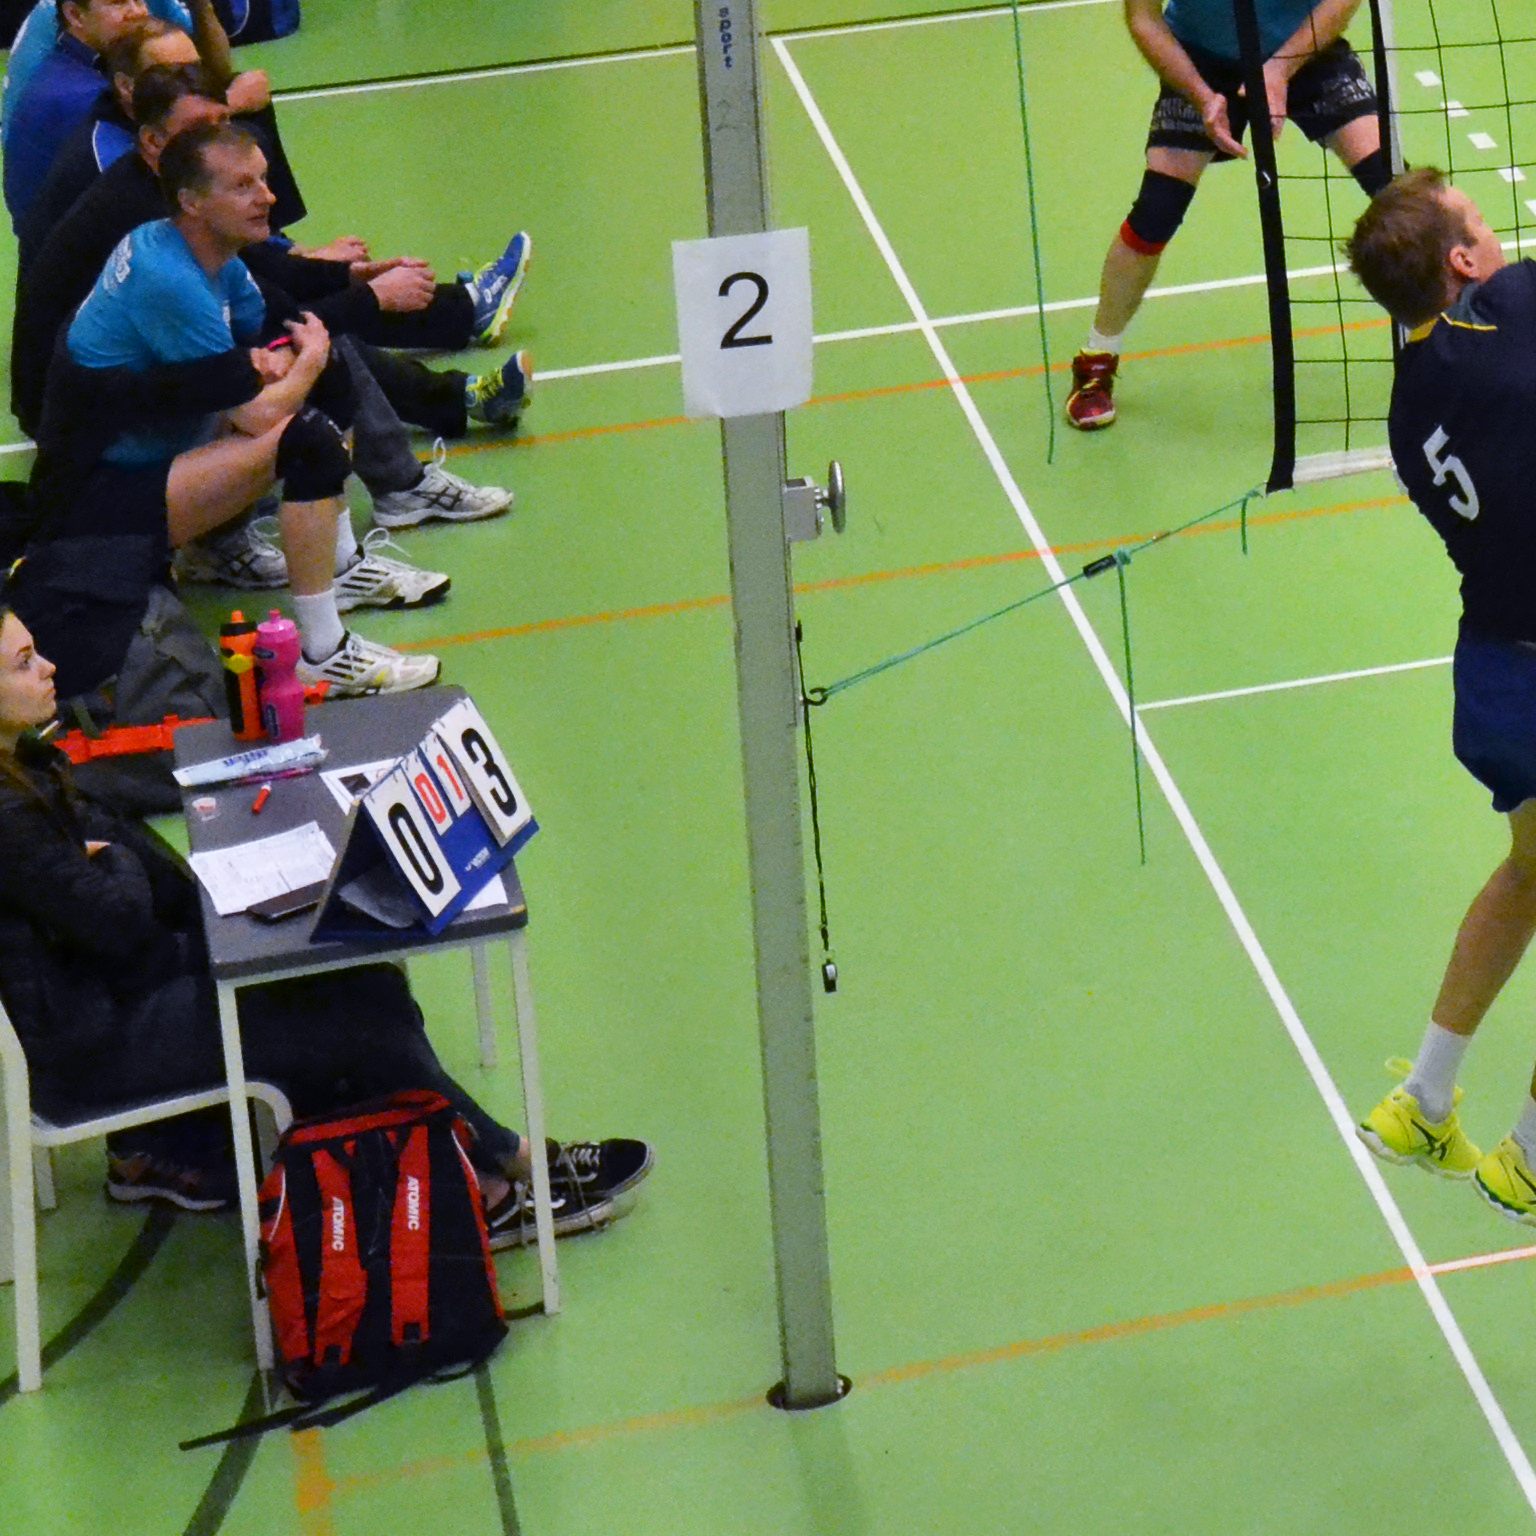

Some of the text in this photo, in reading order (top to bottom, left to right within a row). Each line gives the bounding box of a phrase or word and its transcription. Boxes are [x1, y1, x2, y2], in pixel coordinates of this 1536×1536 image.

[719, 7, 733, 71] sport
[718, 271, 773, 350] 2
[1422, 424, 1480, 521] 5
[414, 772, 447, 825] 0
[436, 753, 465, 802] 1
[460, 727, 518, 818] 3
[387, 801, 445, 896] 0
[331, 1195, 345, 1252] ATOMIC
[406, 1175, 420, 1231] ATOMIC
